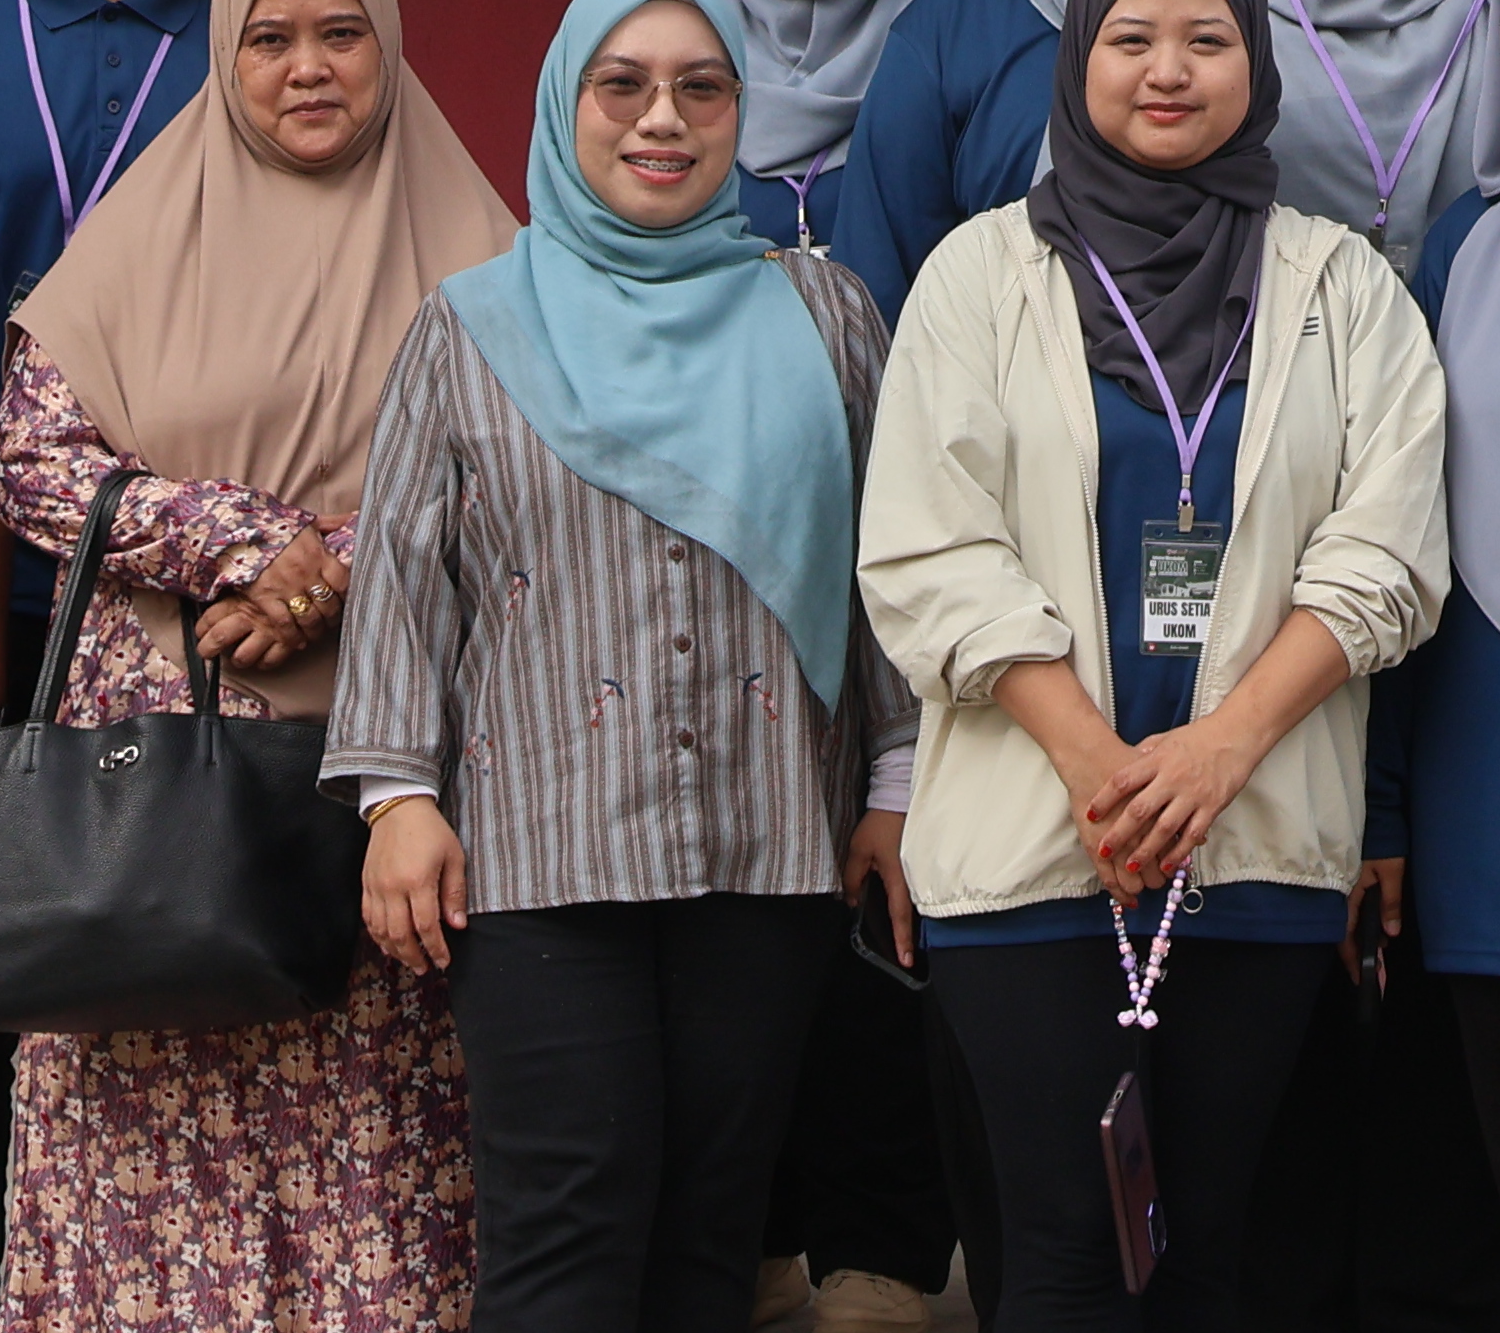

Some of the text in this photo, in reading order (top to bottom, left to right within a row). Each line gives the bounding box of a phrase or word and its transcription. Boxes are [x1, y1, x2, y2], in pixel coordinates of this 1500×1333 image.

[1148, 601, 1211, 618] URUS SETIA
[1163, 623, 1197, 639] UKOM
